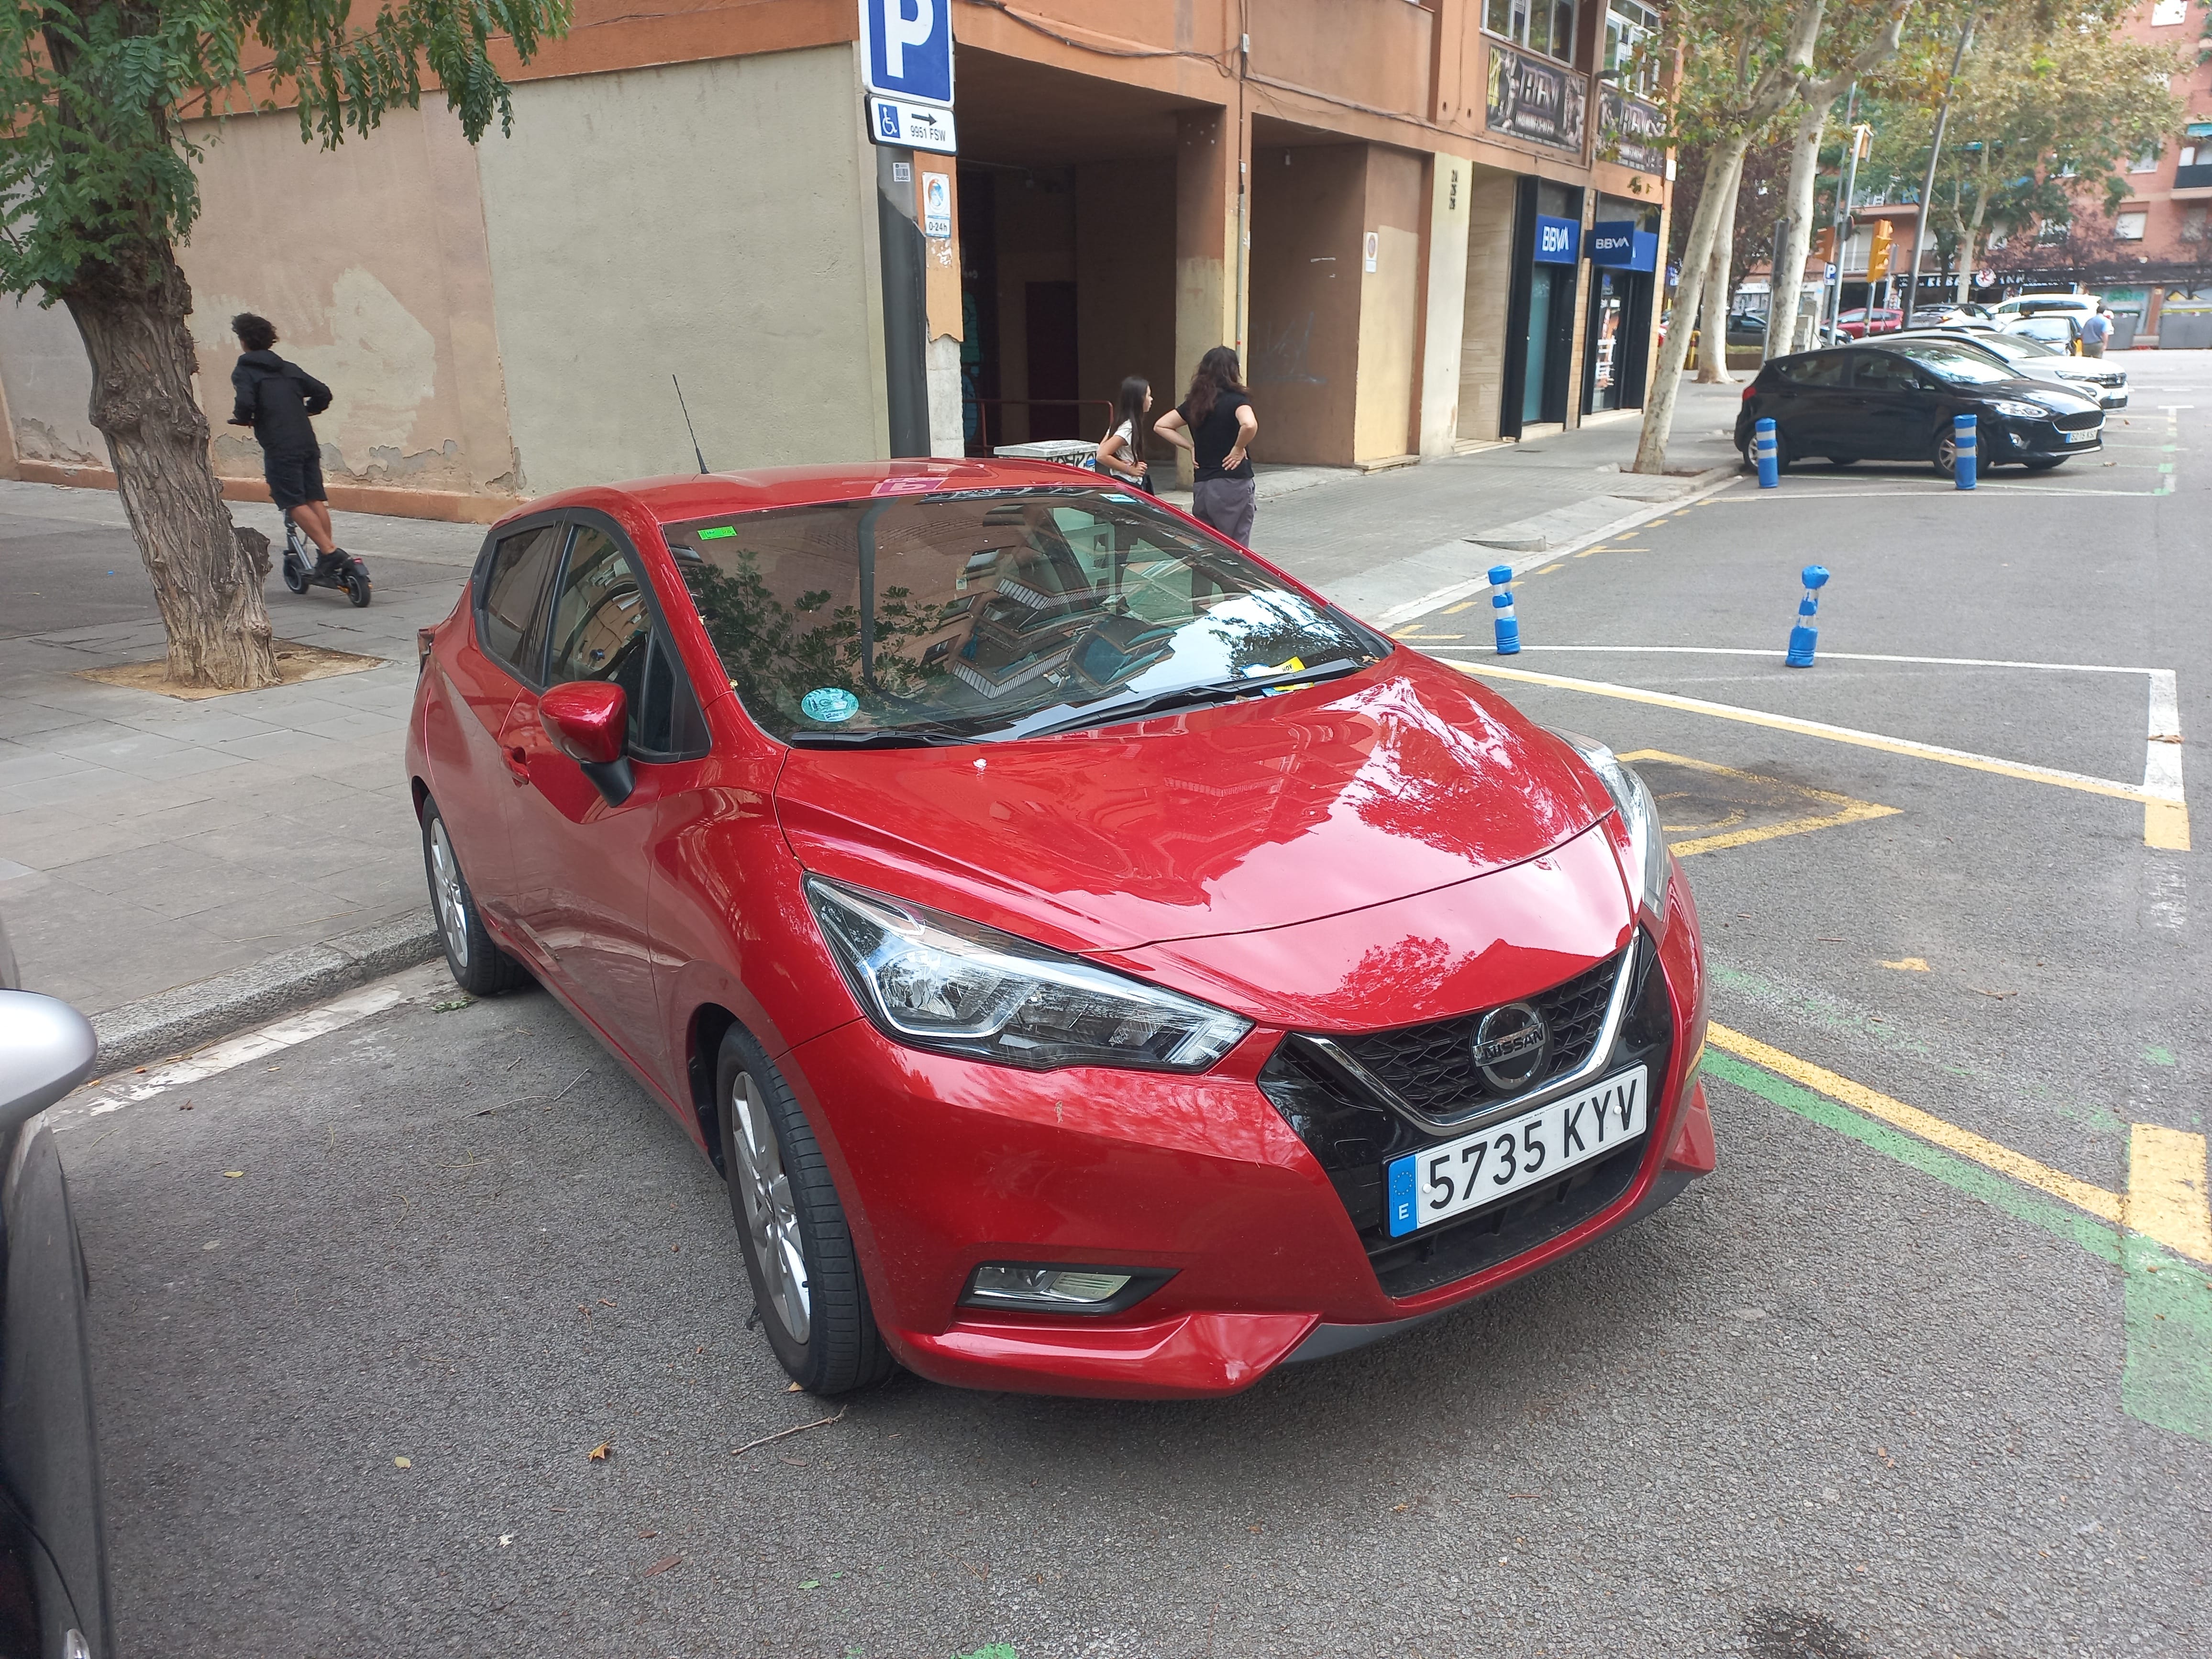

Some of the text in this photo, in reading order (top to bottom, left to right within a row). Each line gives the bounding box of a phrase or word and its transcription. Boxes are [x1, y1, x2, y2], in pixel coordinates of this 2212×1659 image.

[884, 0, 934, 78] P
[910, 125, 946, 142] 9951 FSW
[929, 221, 948, 232] 0-24h
[1542, 226, 1570, 252] BBVA
[1596, 236, 1629, 249] BBVA
[1826, 264, 1836, 278] P
[1483, 1029, 1544, 1061] NISSAN
[1429, 1079, 1637, 1210] 5735 KYV
[1398, 1203, 1409, 1220] E
